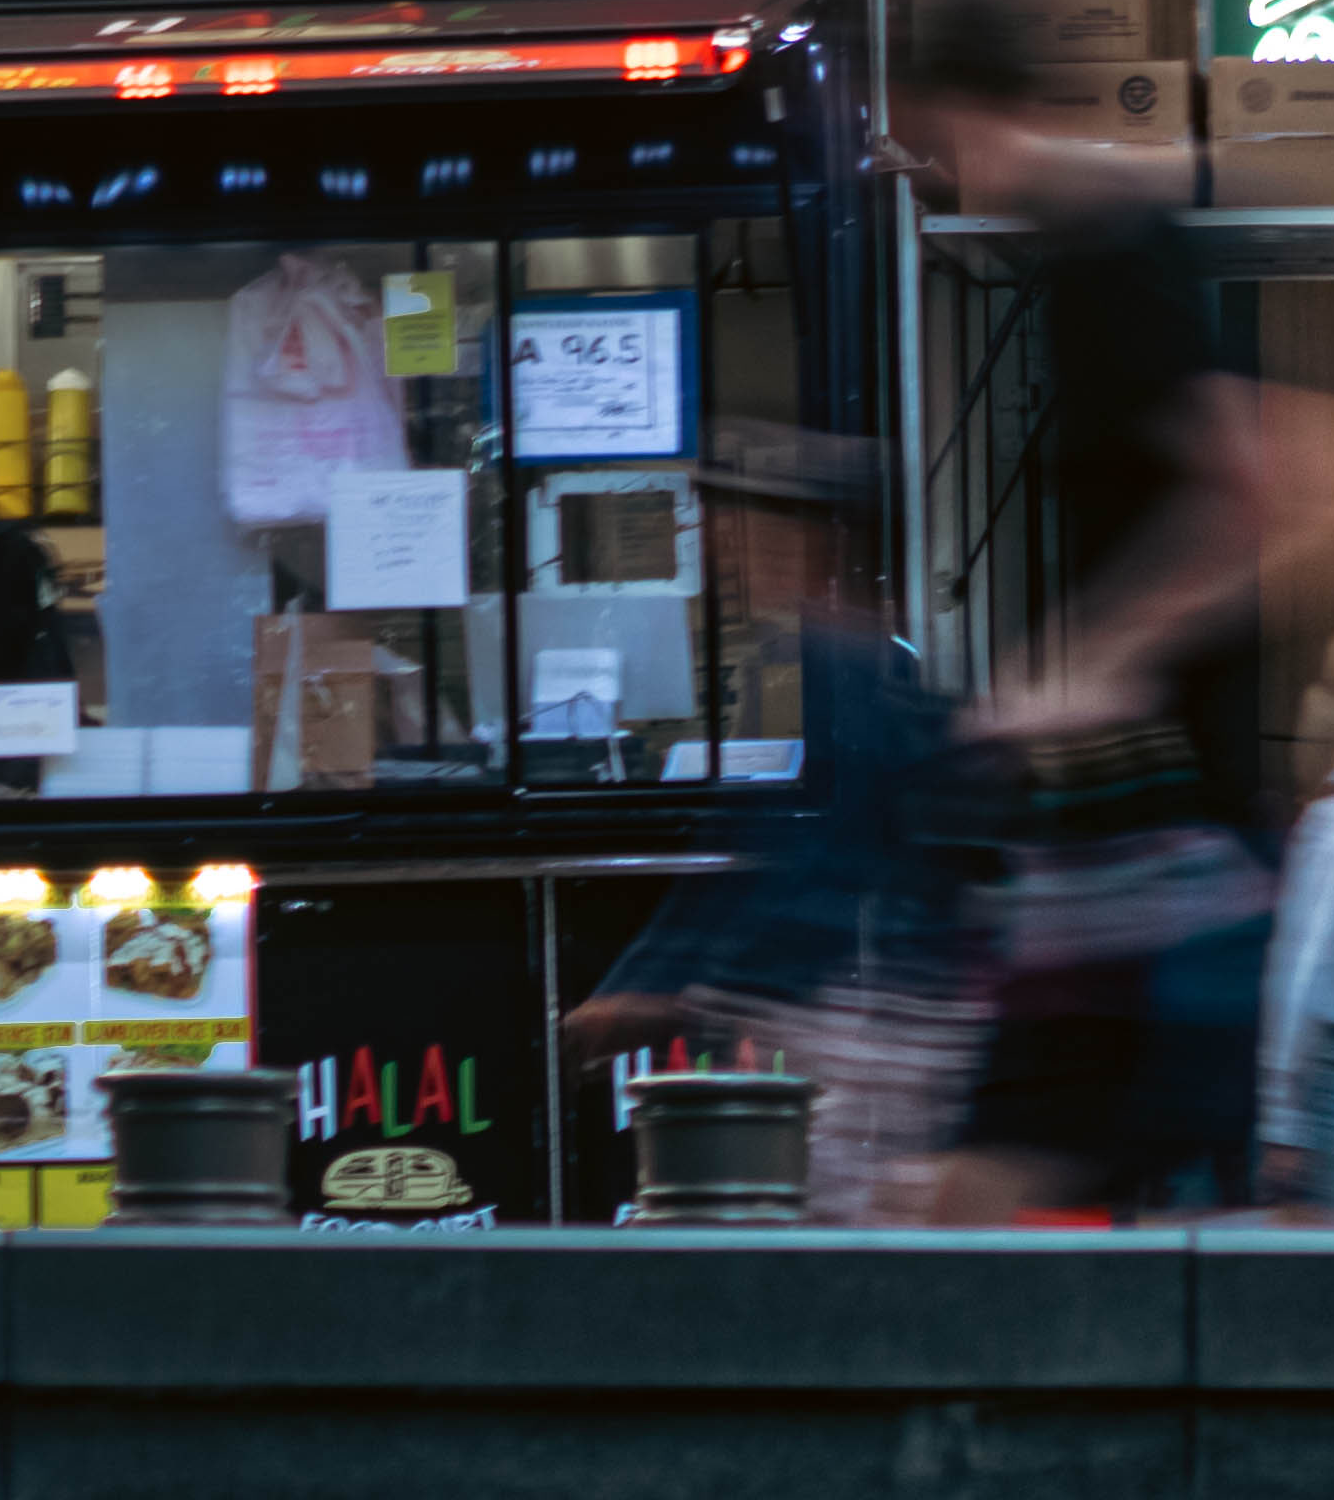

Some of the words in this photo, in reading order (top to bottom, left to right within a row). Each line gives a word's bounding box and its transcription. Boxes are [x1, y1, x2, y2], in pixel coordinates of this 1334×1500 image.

[512, 337, 543, 366] A
[561, 333, 643, 365] 96.5
[297, 1043, 494, 1143] HALAL
